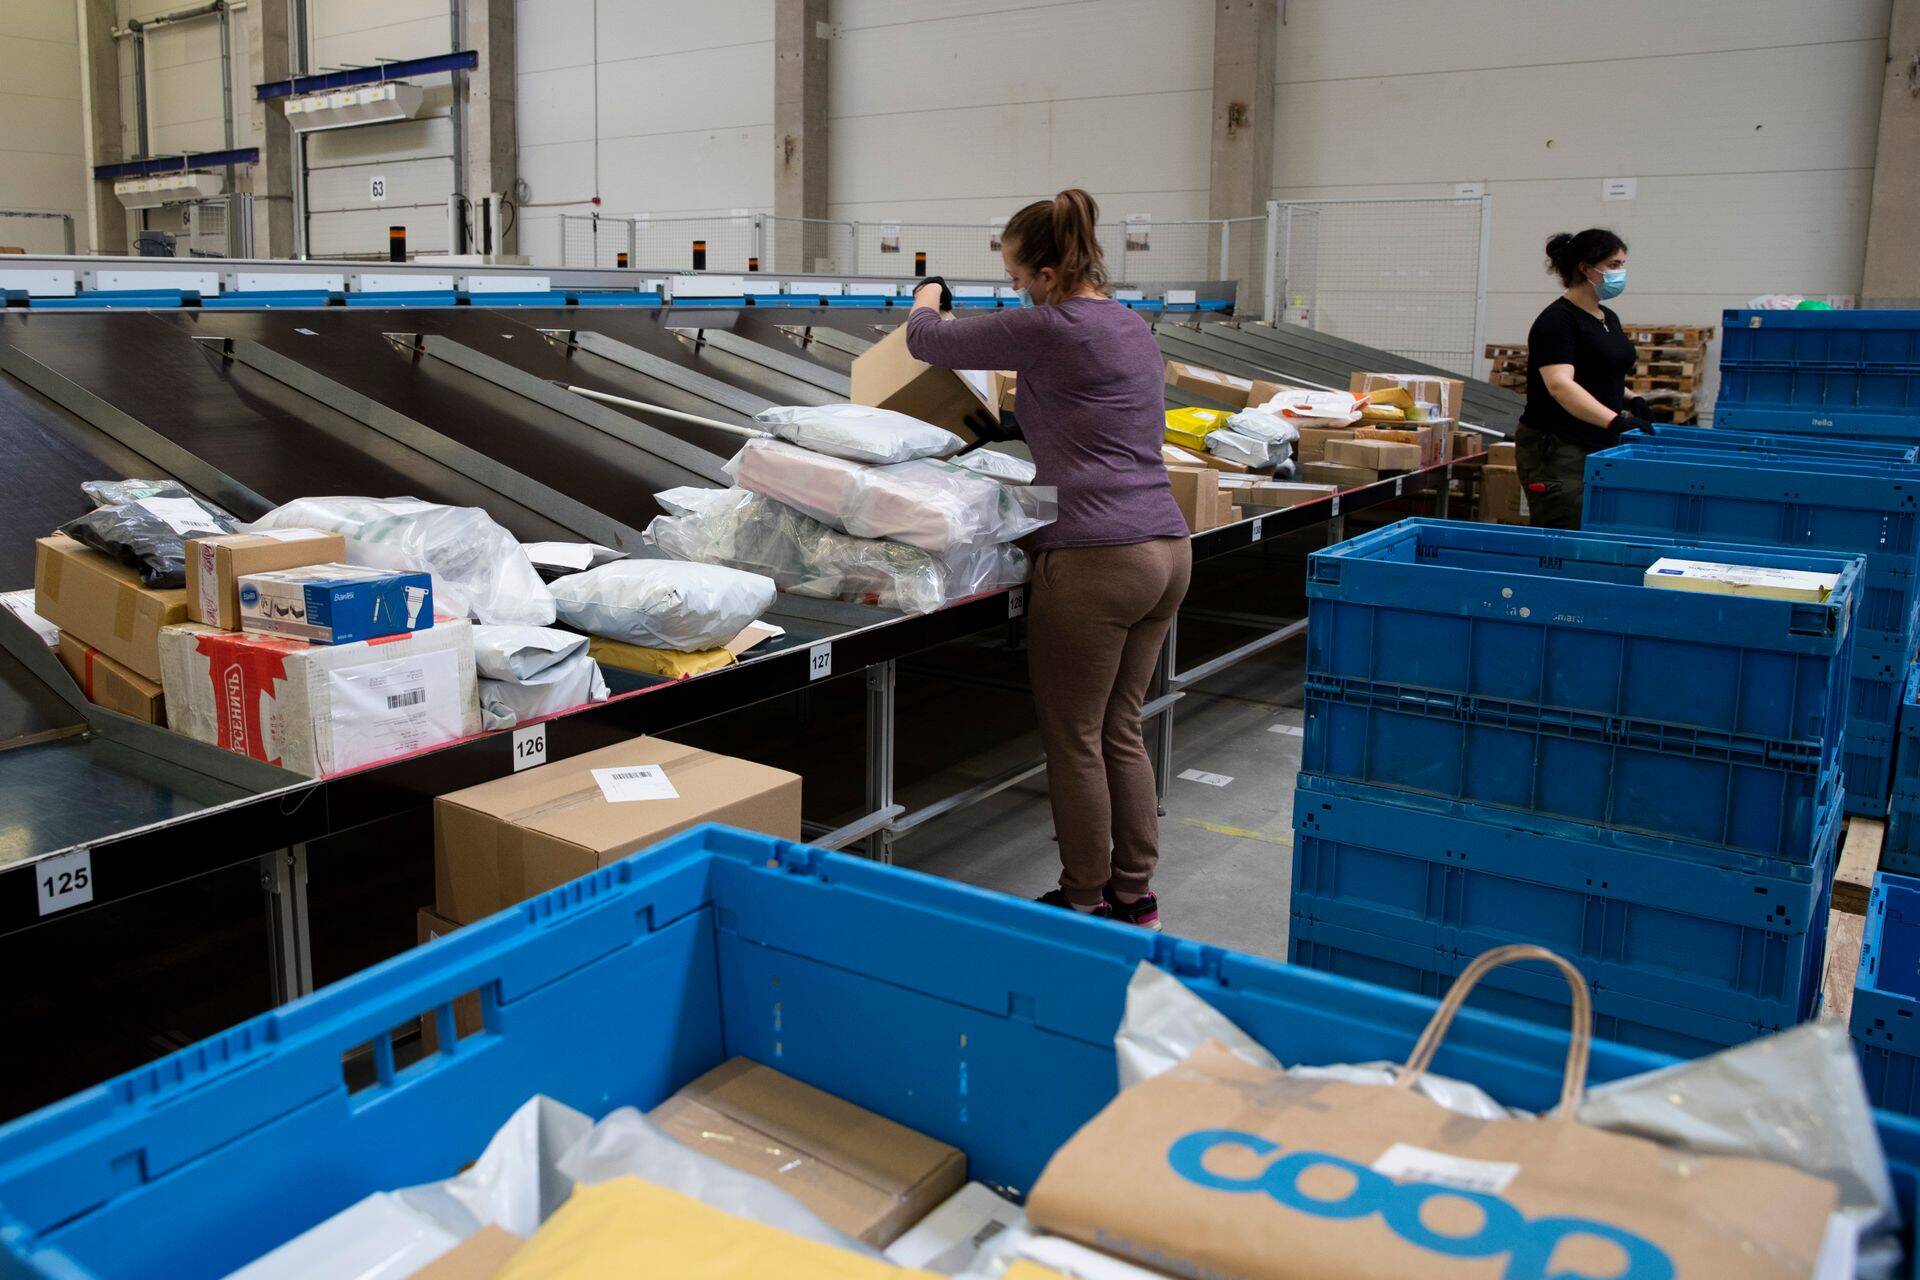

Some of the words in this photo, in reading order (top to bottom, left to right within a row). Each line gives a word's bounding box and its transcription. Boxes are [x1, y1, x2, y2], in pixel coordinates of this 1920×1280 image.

[372, 181, 384, 197] 63
[1010, 595, 1023, 610] 128
[812, 652, 830, 670] 127
[228, 672, 247, 756] РСЕНИЧЪ
[517, 736, 544, 758] 126
[43, 867, 89, 898] 125
[1167, 1128, 1677, 1280] coop
